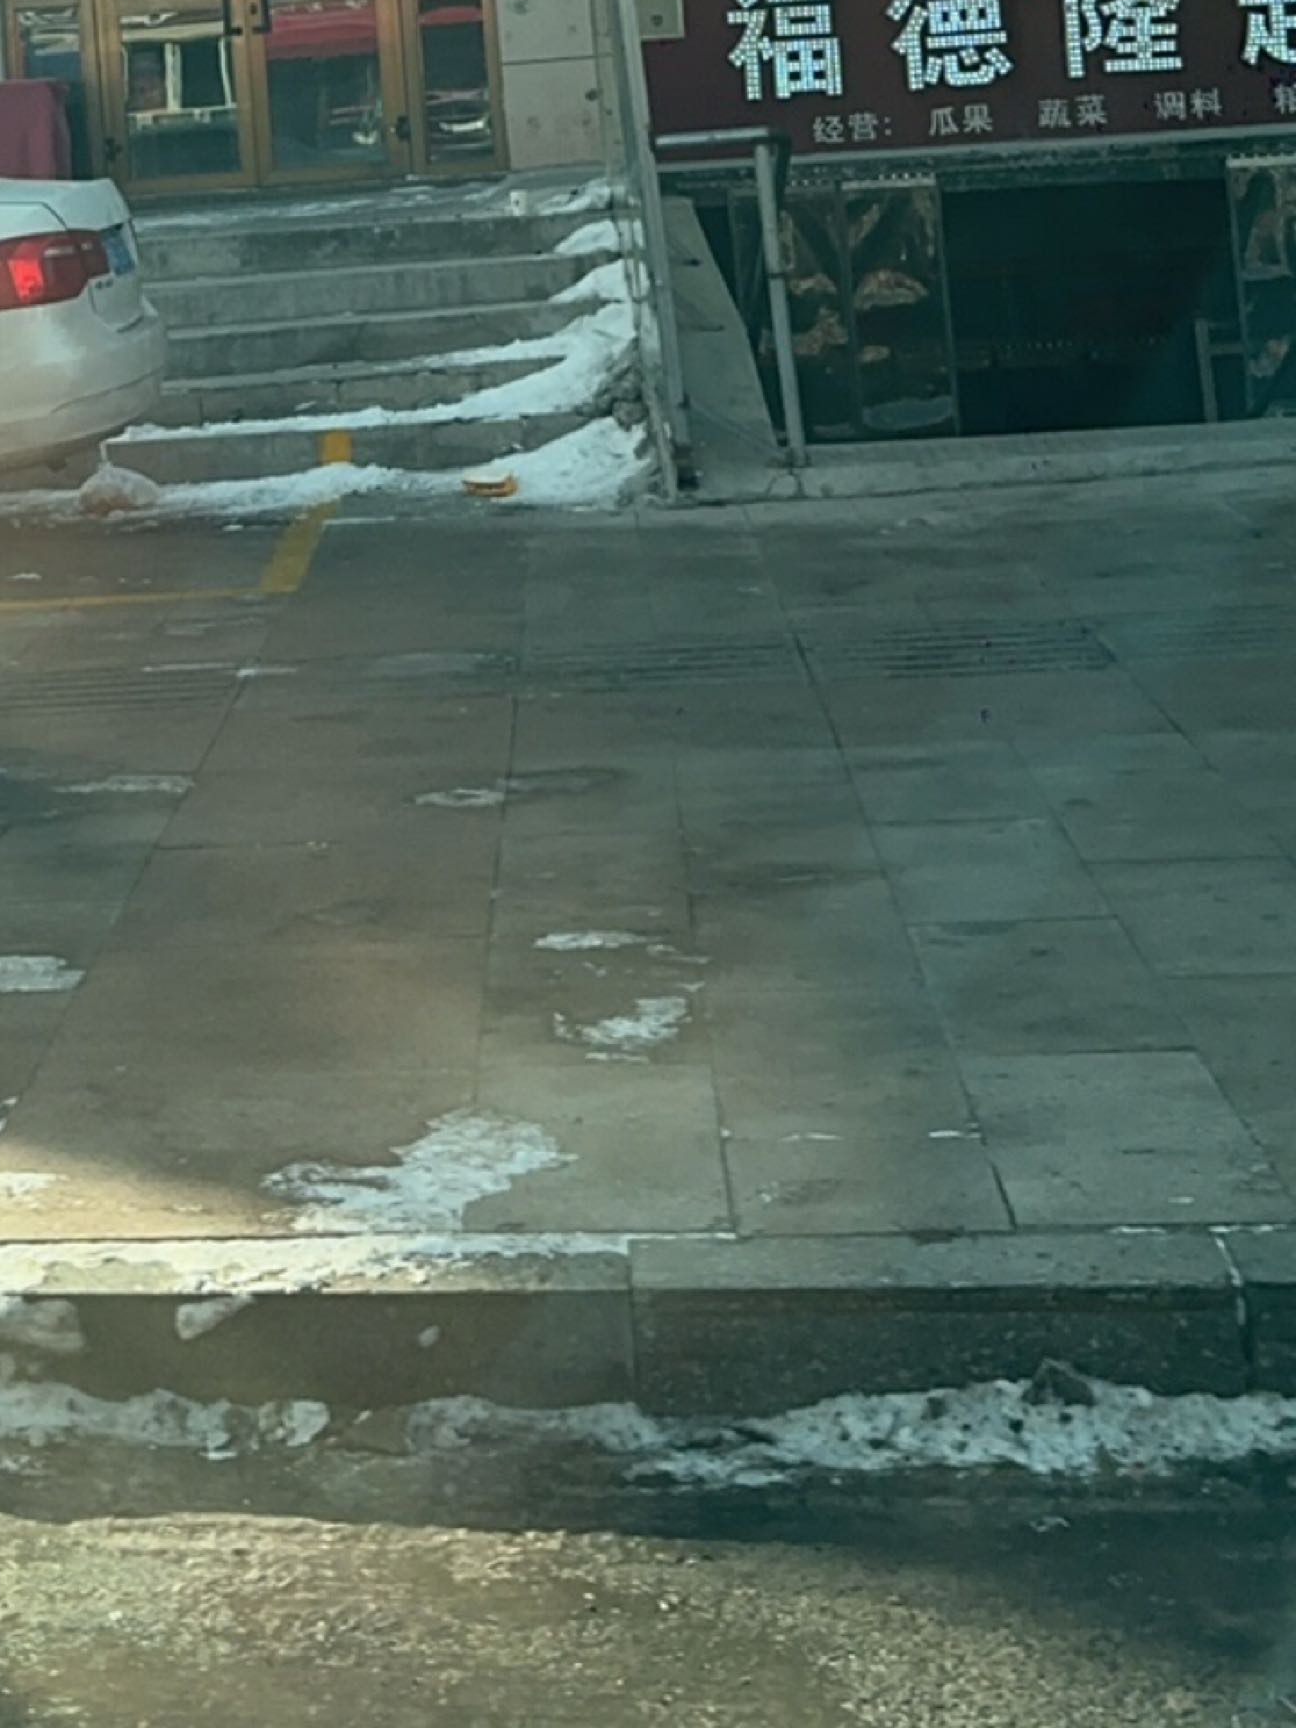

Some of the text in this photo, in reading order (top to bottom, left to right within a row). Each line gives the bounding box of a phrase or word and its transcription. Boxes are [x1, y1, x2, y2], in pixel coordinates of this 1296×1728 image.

[928, 102, 994, 136] 瓜果
[1037, 94, 1109, 129] 蔬菜
[1153, 86, 1223, 121] 调料
